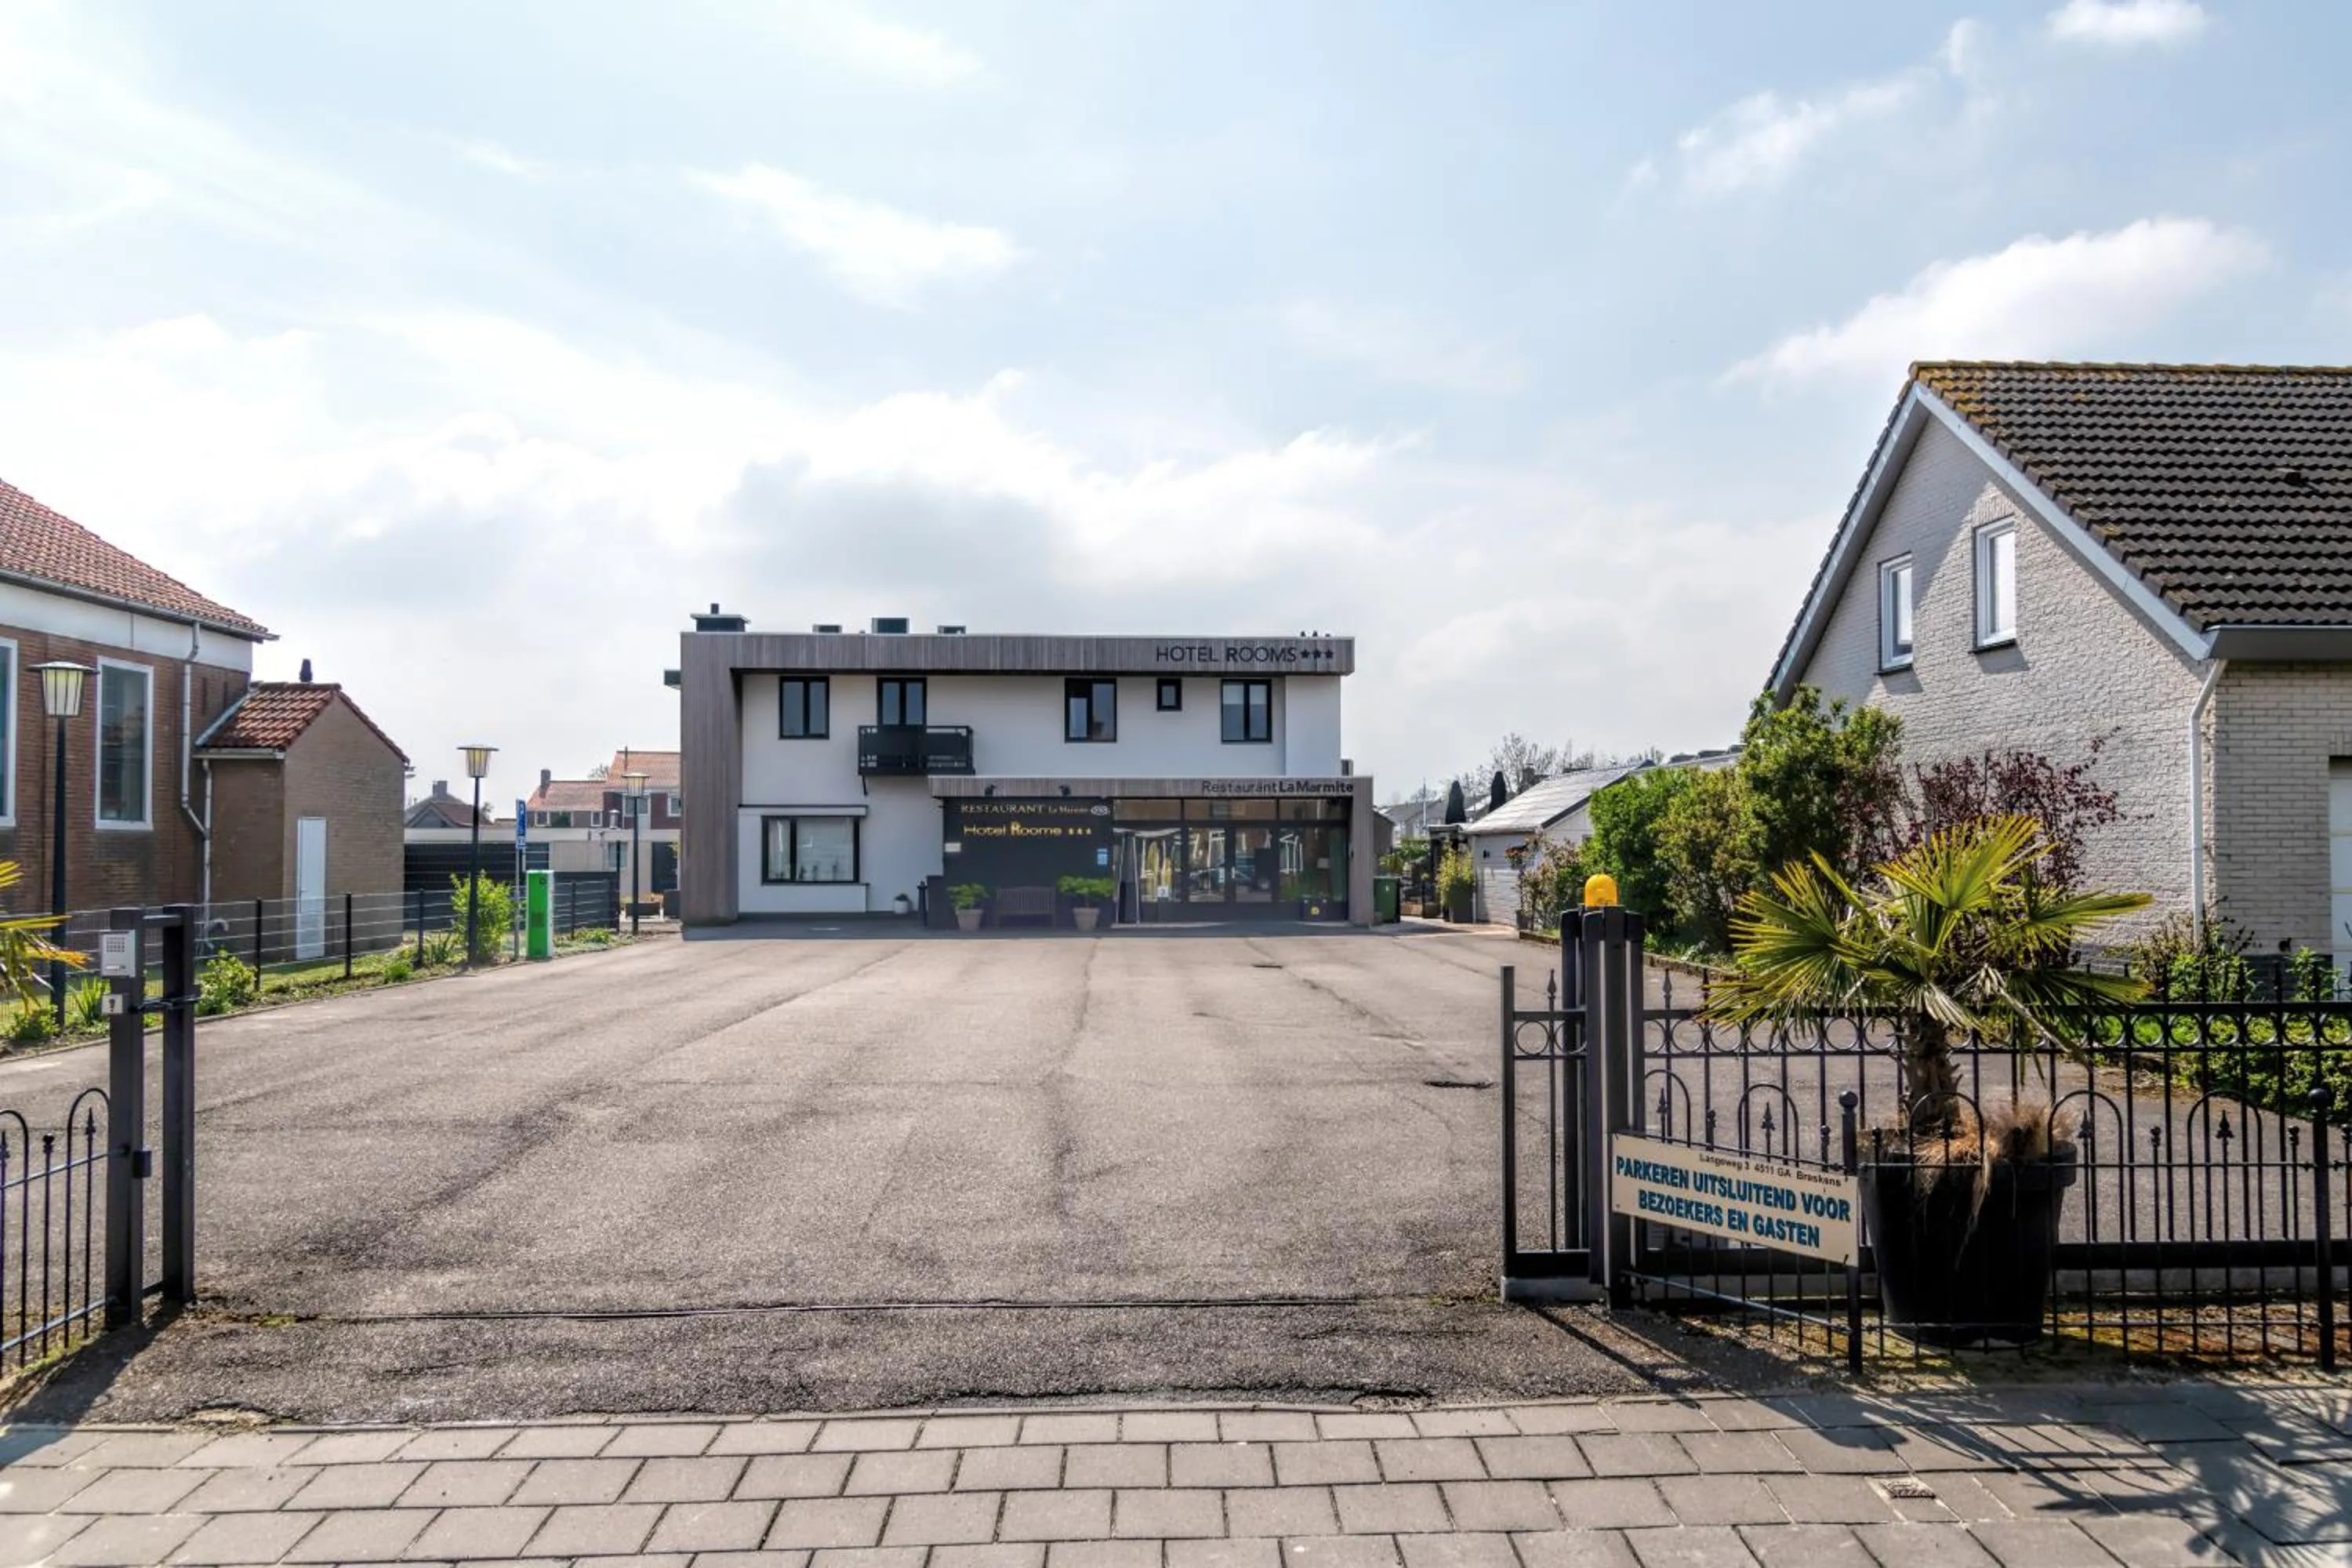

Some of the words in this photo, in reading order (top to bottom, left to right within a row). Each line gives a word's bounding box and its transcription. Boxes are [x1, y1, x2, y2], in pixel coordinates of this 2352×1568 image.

[1156, 646, 1218, 662] HOTEL
[1226, 646, 1296, 662] ROOMS
[1203, 780, 1277, 793] Restaurant
[960, 804, 1044, 813] RESTAURANT
[964, 825, 1006, 836] Hotel
[1755, 1163, 1775, 1174] 4511
[1777, 1167, 1791, 1178] GA
[1616, 1156, 1690, 1191] PARKEREN
[1693, 1171, 1796, 1210] UITSLUITEND
[1801, 1192, 1850, 1221] VOOR
[1639, 1189, 1723, 1227] BEZOEKERS
[1727, 1208, 1748, 1232] EN
[1753, 1214, 1820, 1248] GASTEN
